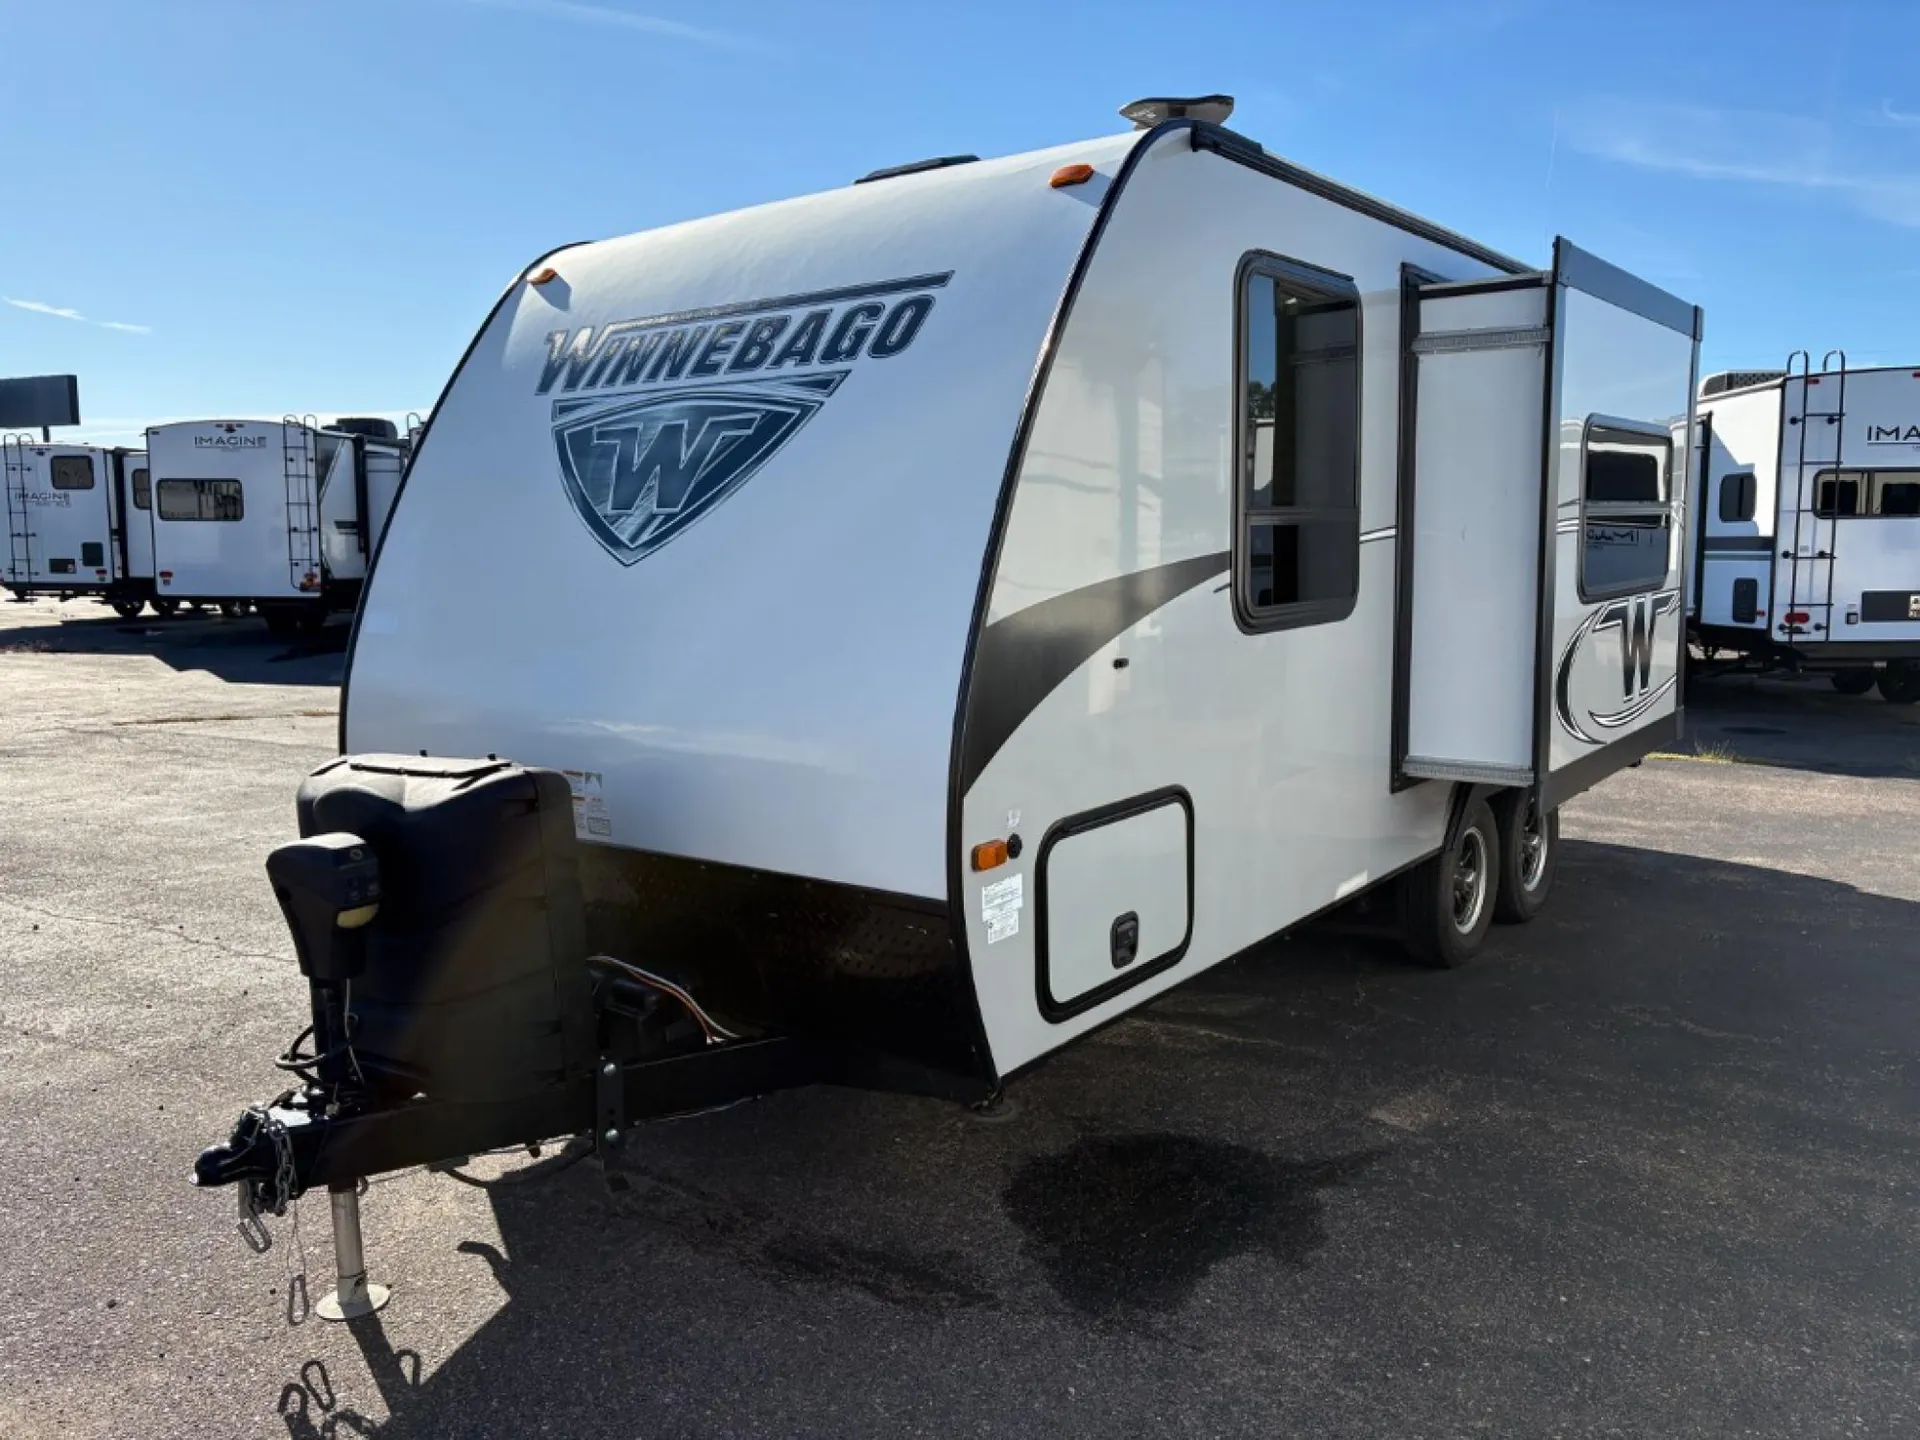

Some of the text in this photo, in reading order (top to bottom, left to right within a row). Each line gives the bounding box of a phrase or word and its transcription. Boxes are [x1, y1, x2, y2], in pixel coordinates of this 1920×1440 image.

[534, 292, 938, 396] WINNEBAGO
[194, 435, 268, 447] IMAGINE
[593, 410, 766, 515] W
